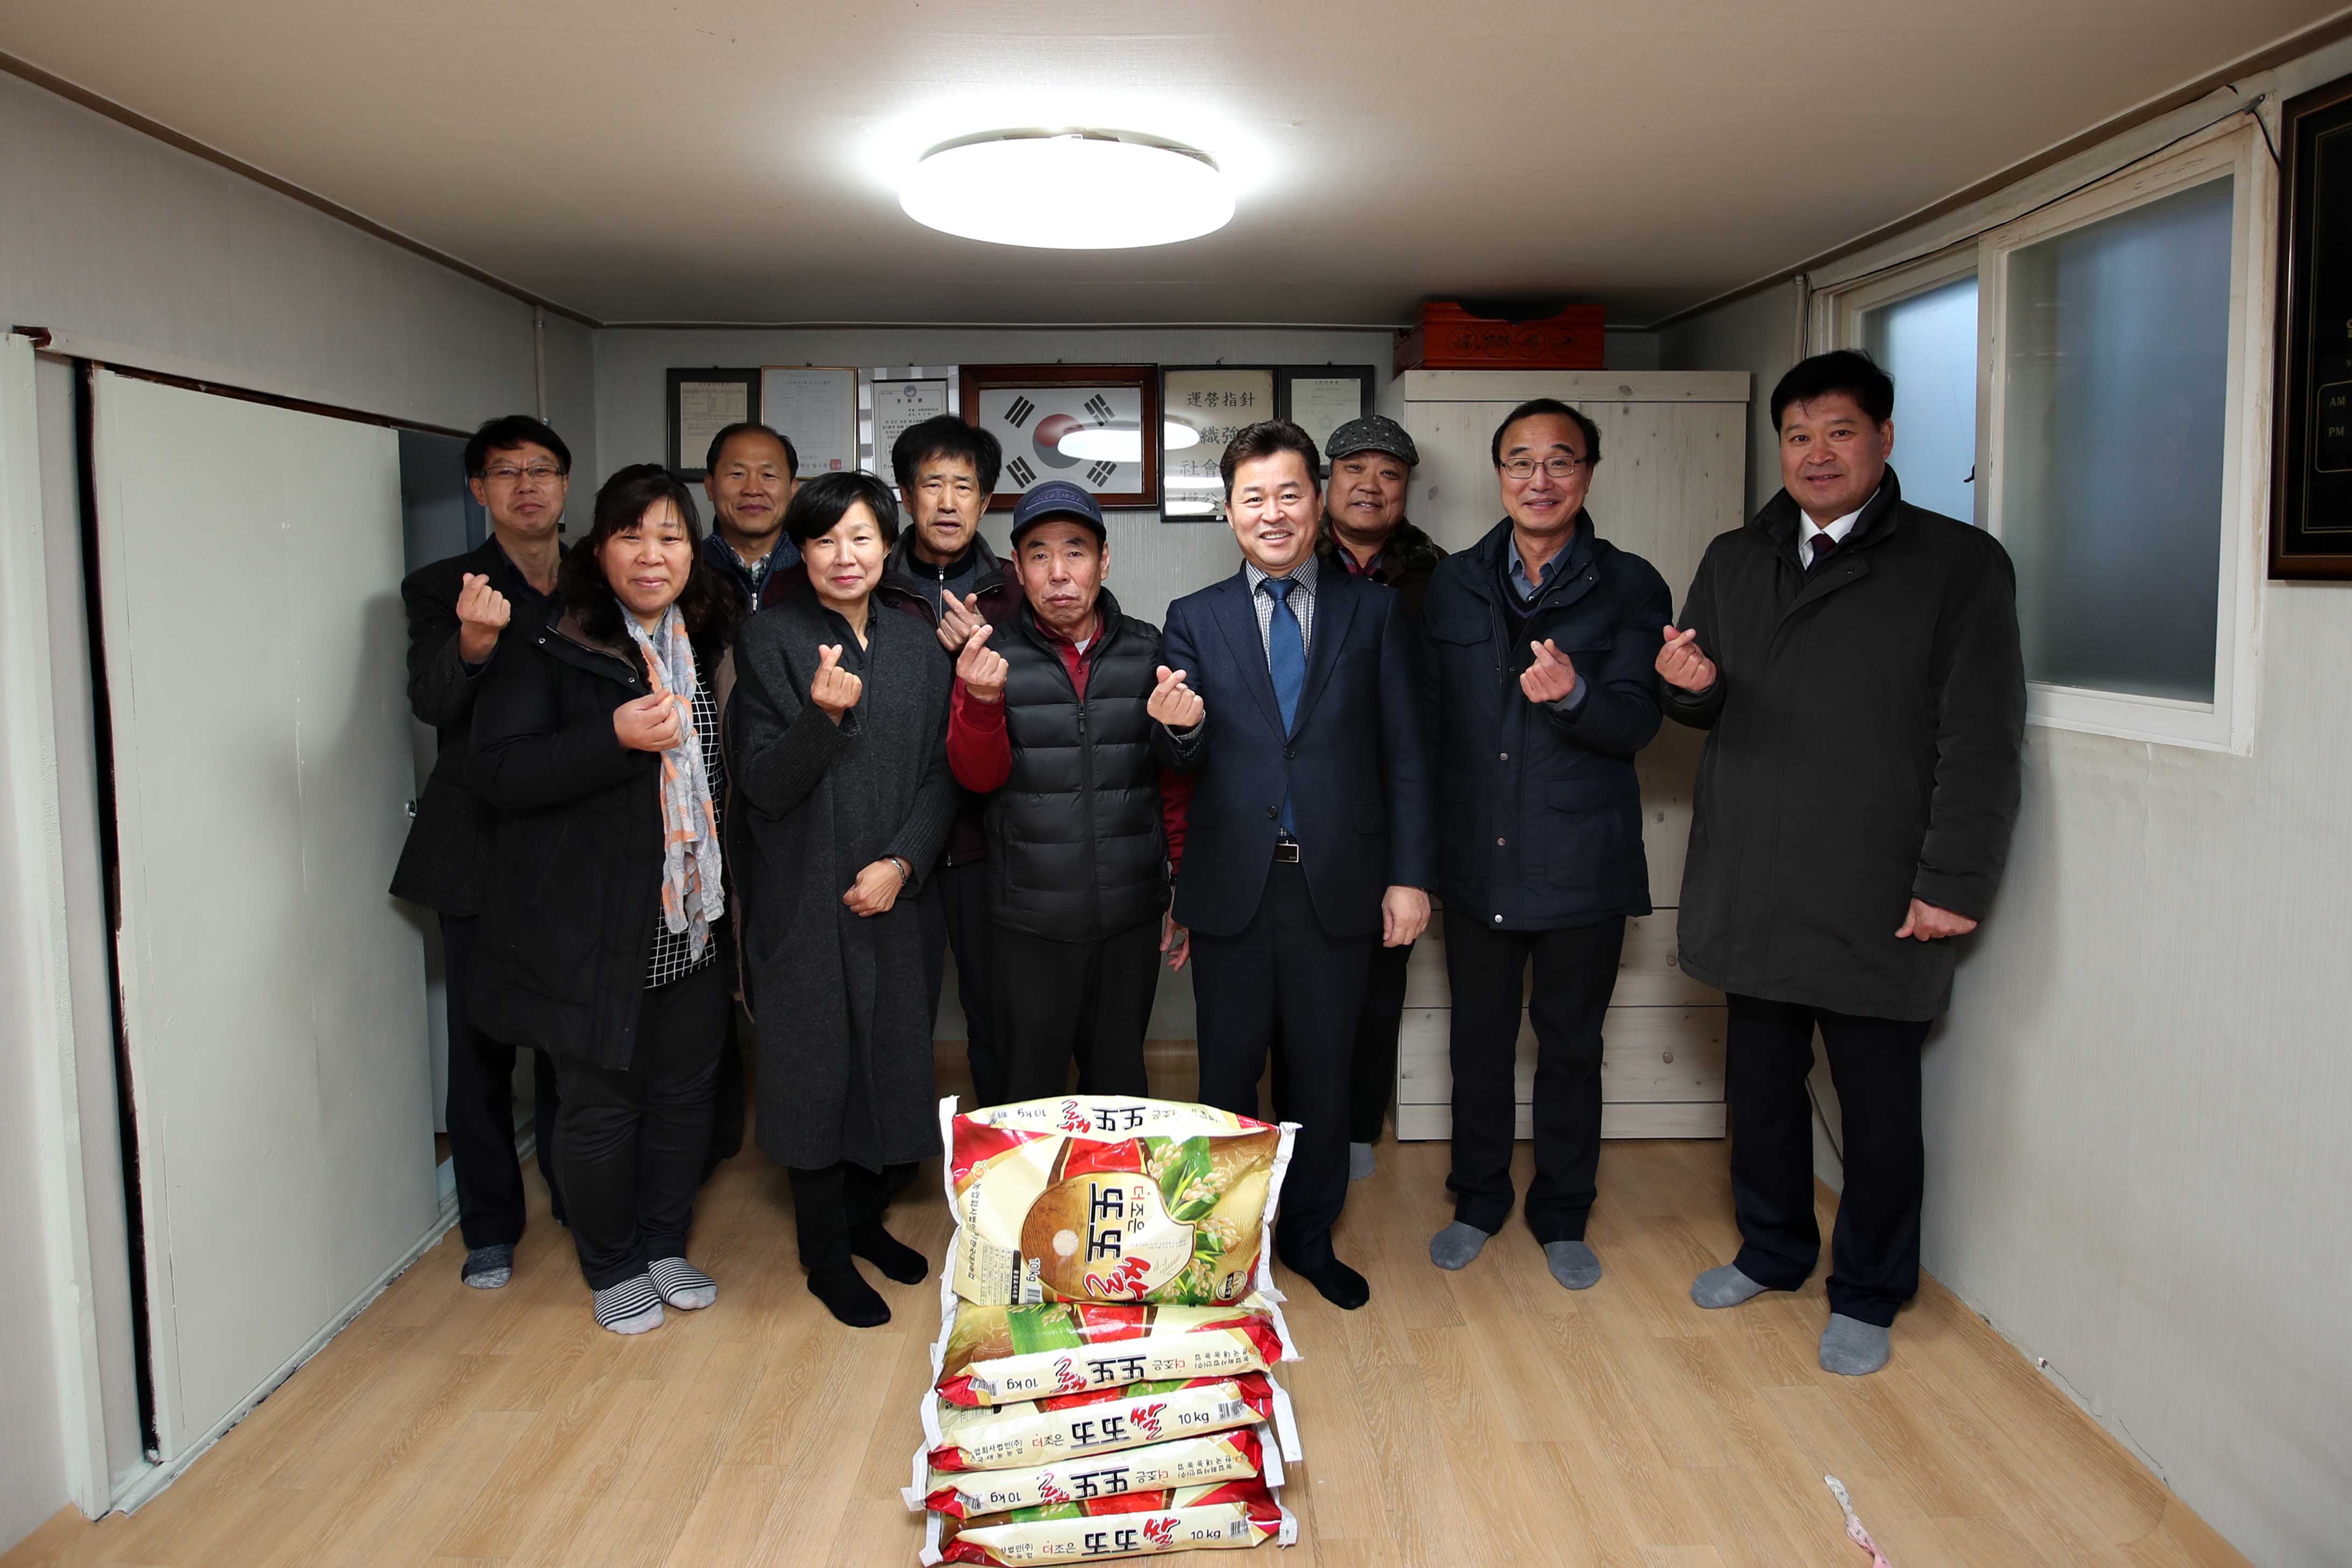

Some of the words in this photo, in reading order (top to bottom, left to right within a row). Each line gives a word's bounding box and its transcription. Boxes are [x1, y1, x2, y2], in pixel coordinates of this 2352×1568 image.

[1187, 391, 1255, 408] 運營指針
[2329, 396, 2346, 407] AM
[2329, 426, 2344, 437] PM
[1128, 1186, 1150, 1233] 더조은
[1152, 1358, 1186, 1373] 더조은
[972, 1438, 1023, 1456] 업회사법인(주)
[1032, 1433, 1065, 1448] 더조은
[1136, 1469, 1169, 1484] 더조은
[1042, 1540, 1076, 1555] 더조은
